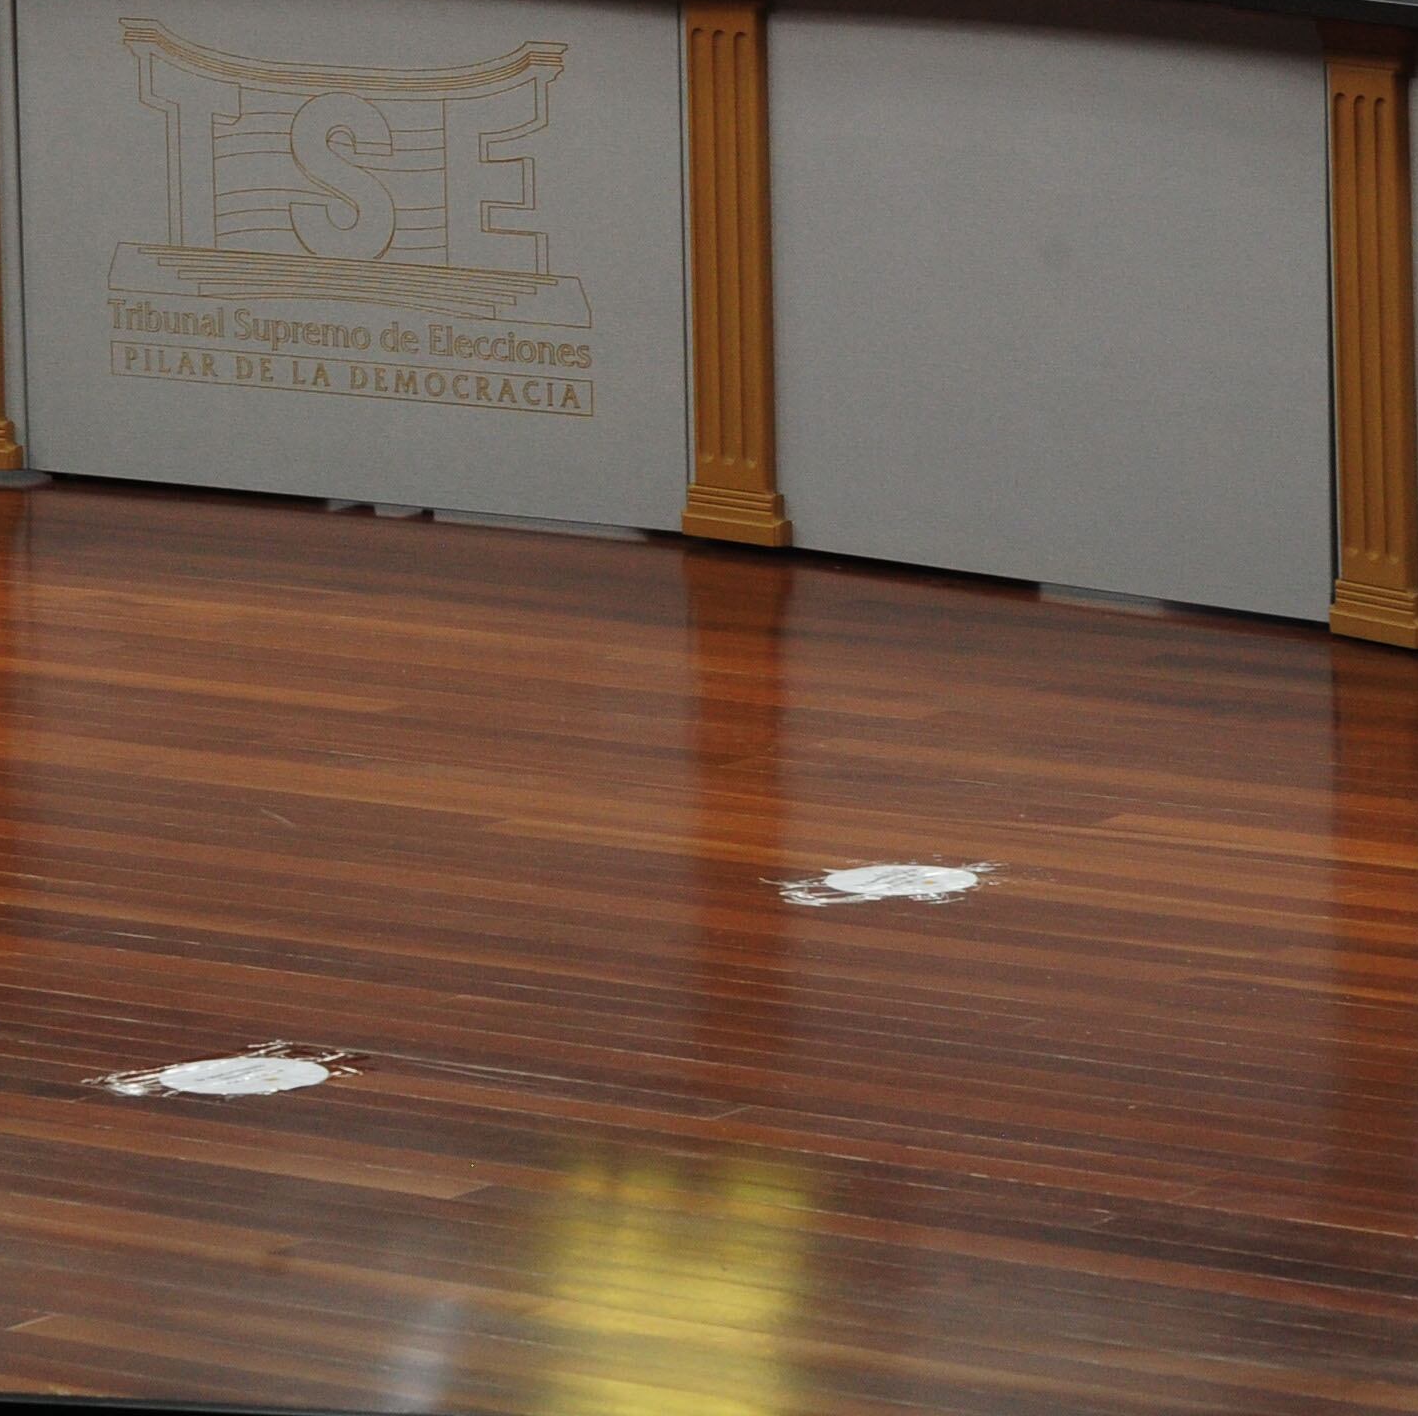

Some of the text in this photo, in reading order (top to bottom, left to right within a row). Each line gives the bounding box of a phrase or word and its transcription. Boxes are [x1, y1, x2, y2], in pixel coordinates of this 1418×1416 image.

[107, 298, 593, 369] Tribunal Supremo de Elecciones
[124, 346, 581, 409] PILAR DE LA DEMOCRACIA
